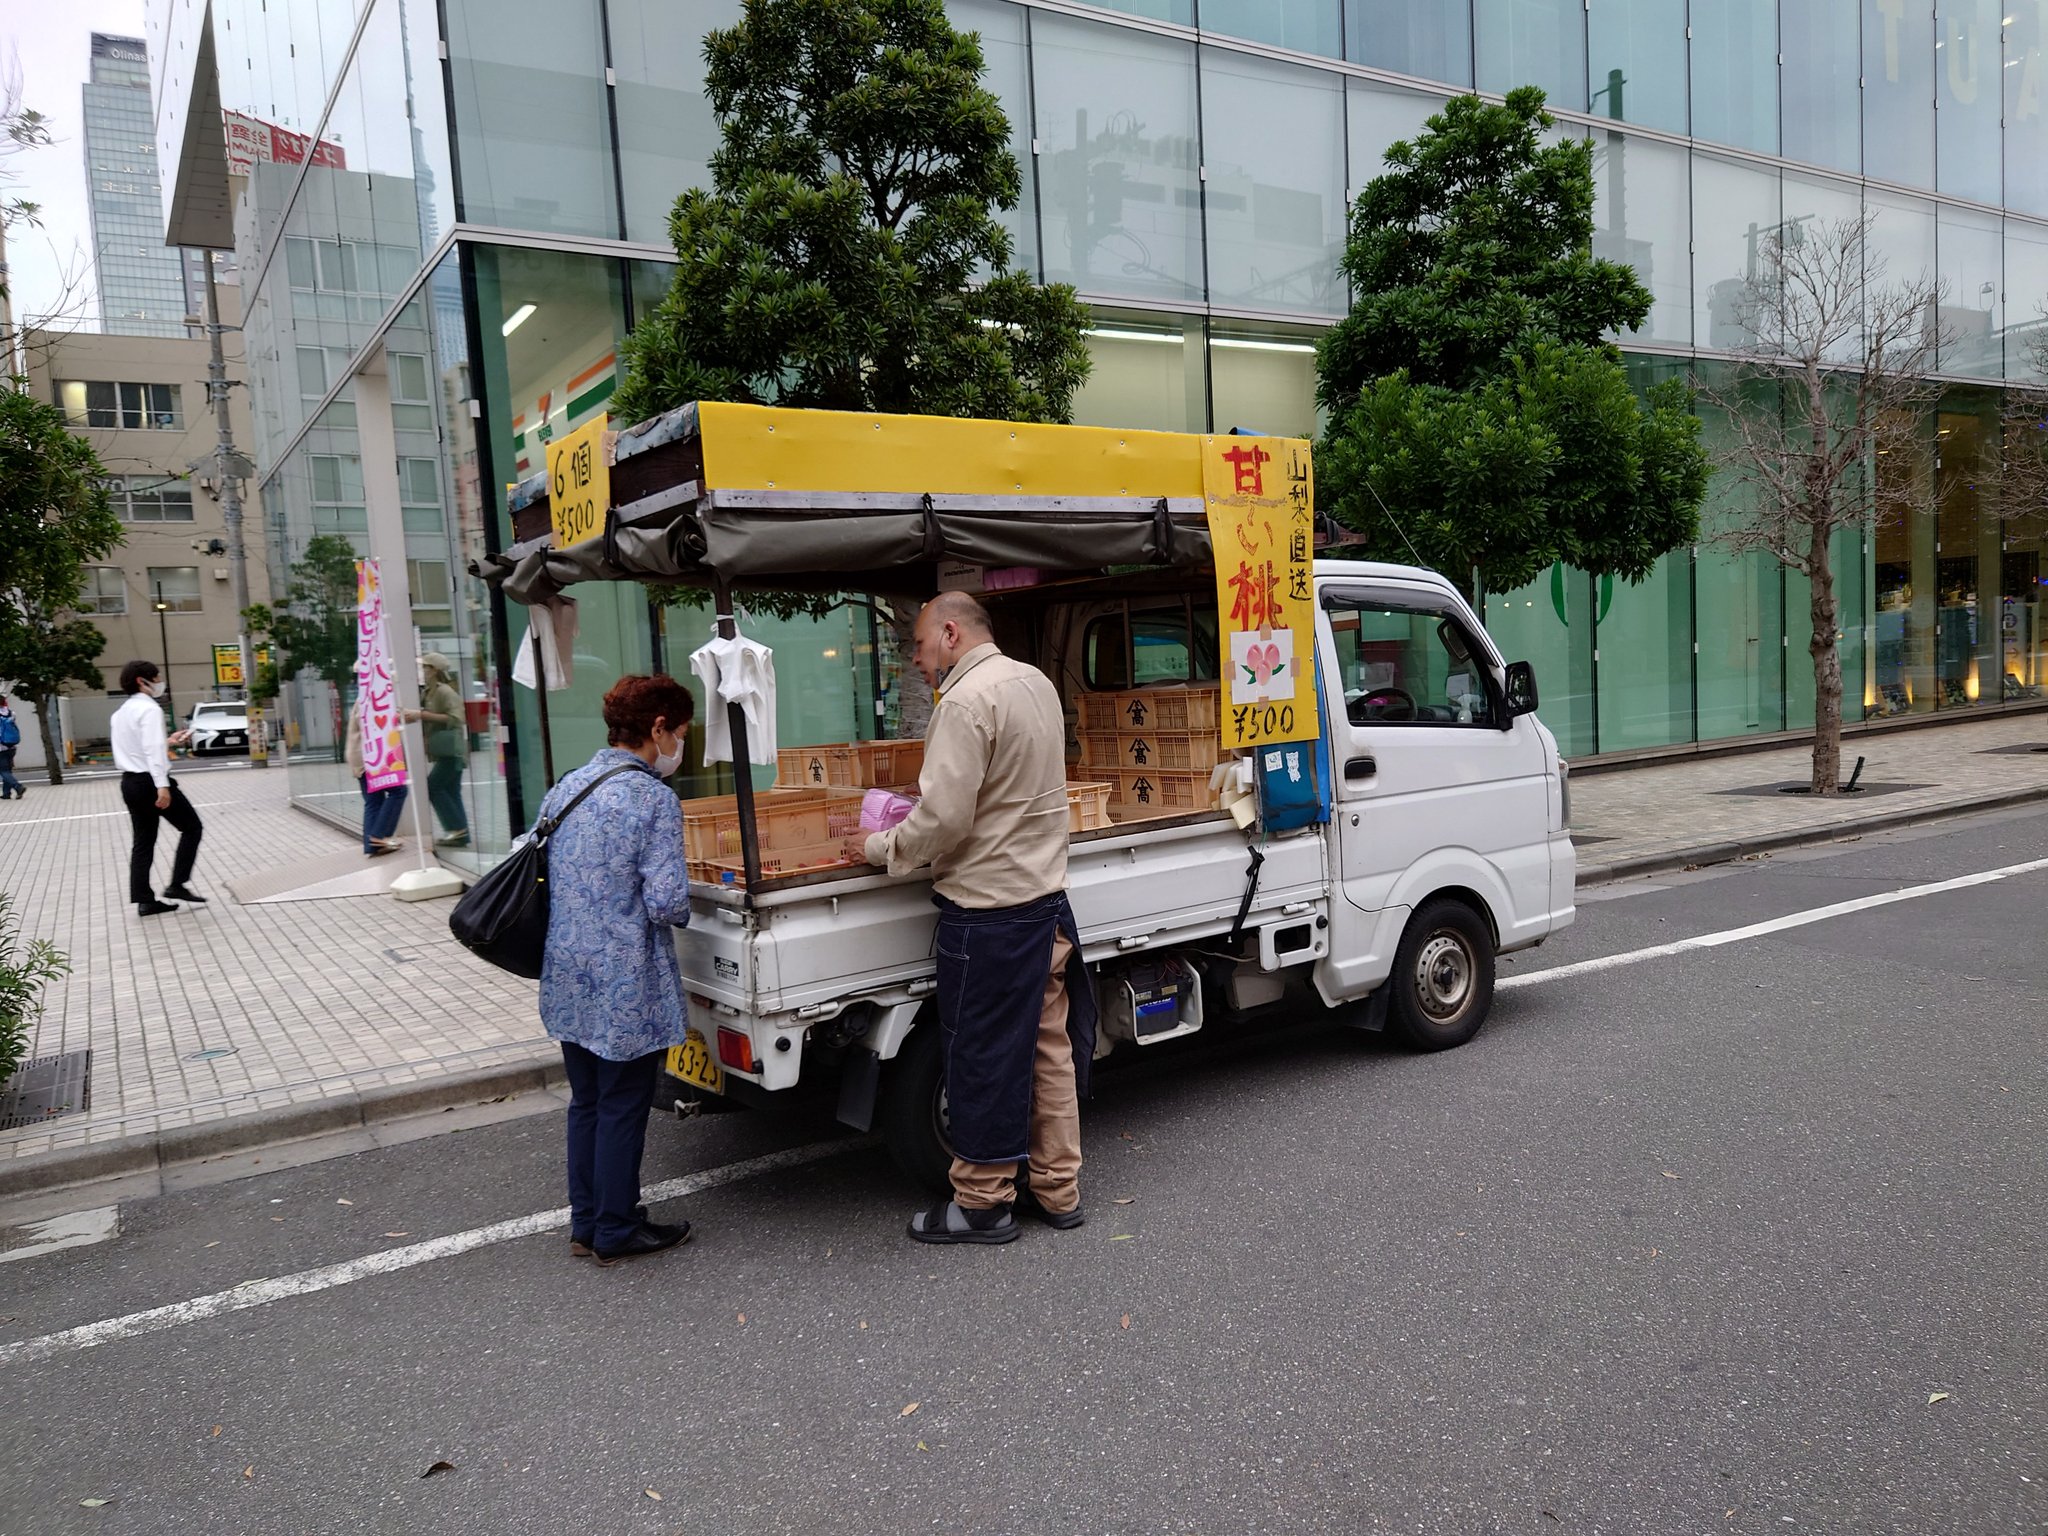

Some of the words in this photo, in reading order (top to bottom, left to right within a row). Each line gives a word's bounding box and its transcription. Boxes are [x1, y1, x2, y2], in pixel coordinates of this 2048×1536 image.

[111, 47, 147, 63] Olinas
[555, 440, 591, 499] 6個
[557, 499, 594, 546] ¥500
[1233, 705, 1295, 742] ¥500
